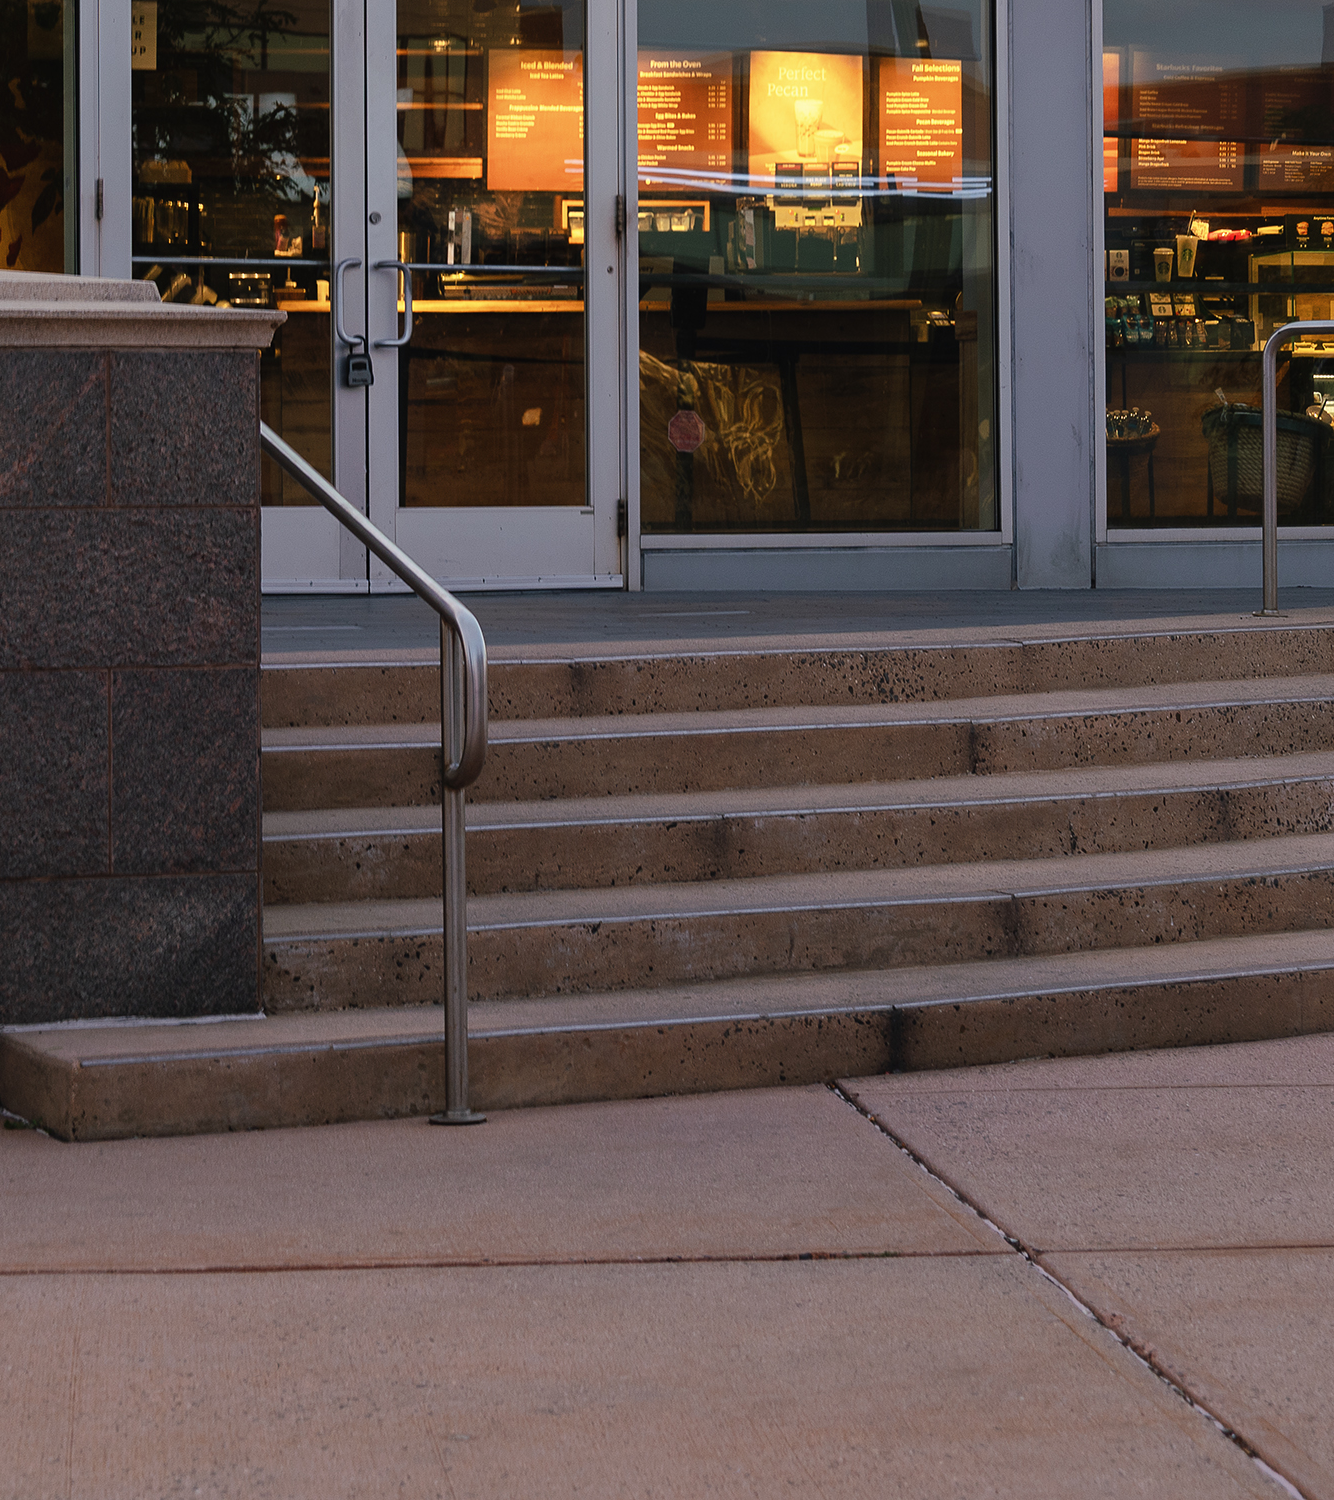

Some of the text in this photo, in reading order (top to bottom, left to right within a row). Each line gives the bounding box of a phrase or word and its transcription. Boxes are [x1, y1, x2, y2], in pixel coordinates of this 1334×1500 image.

[650, 60, 701, 68] From the Oven
[912, 64, 960, 72] Fall Selections
[778, 66, 827, 81] Perfect
[767, 83, 809, 97] Pecan
